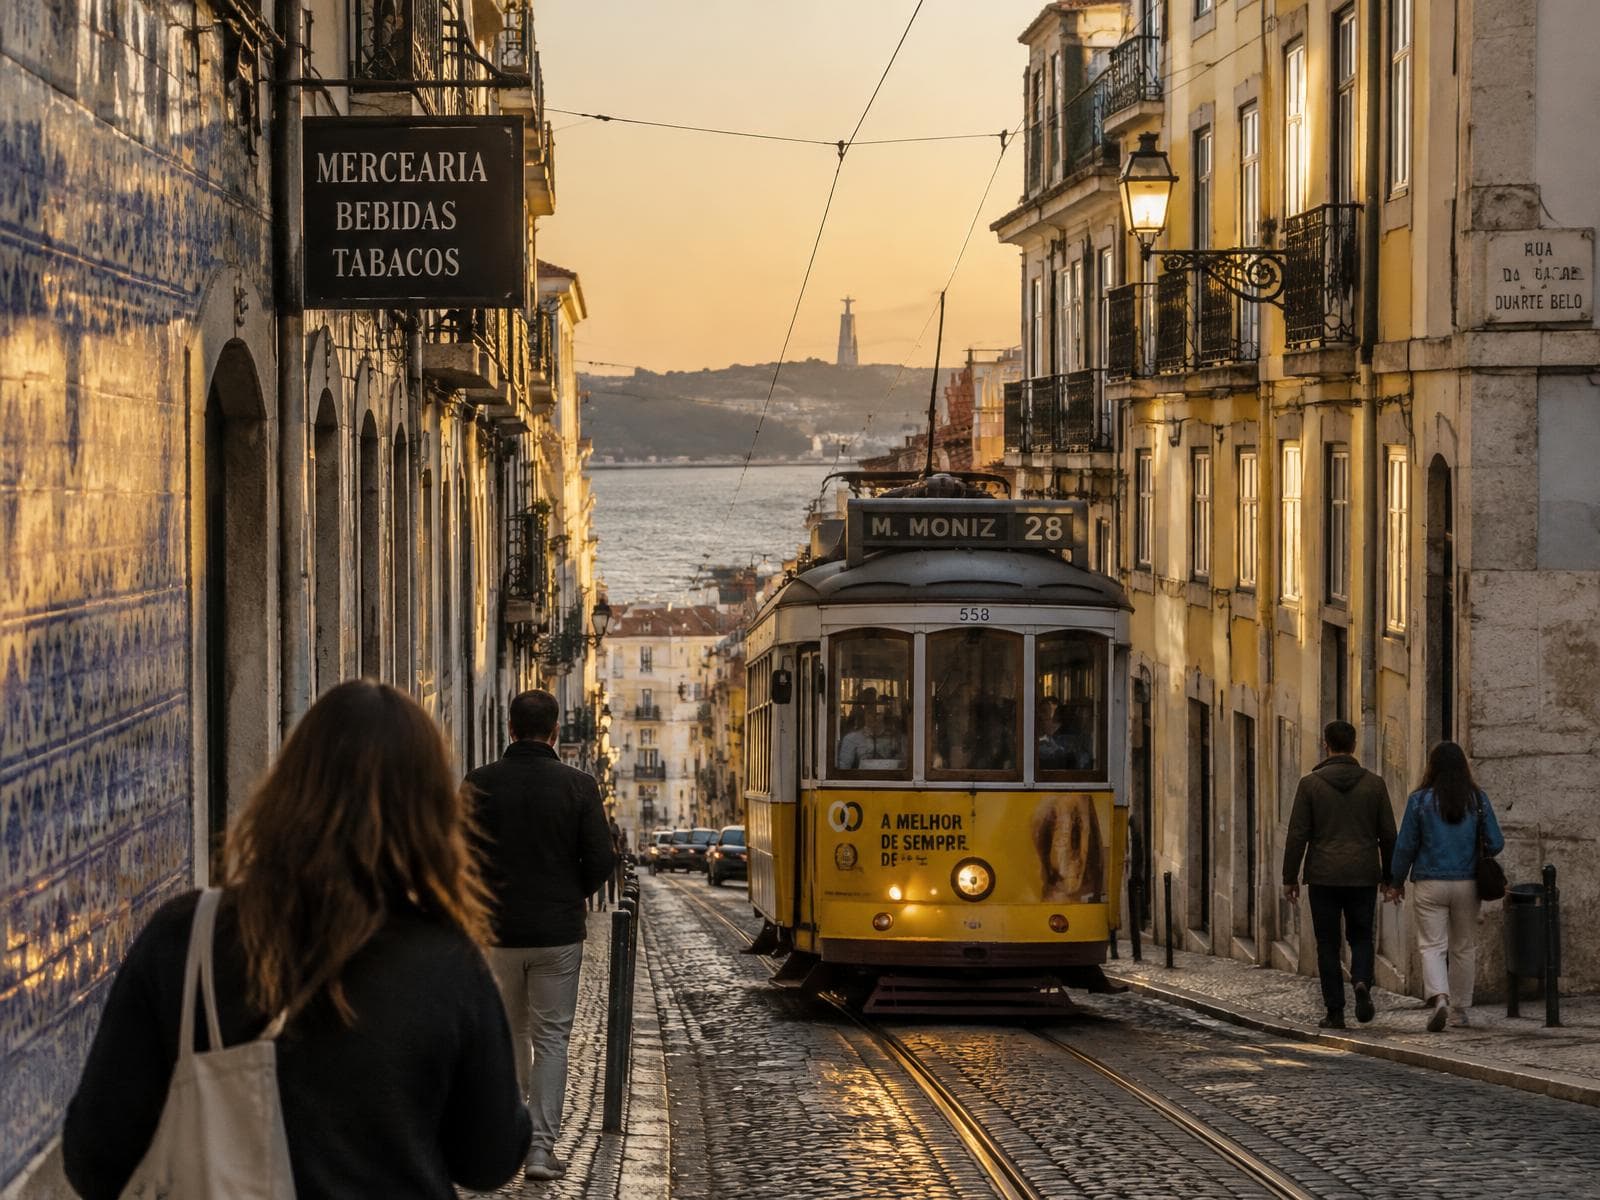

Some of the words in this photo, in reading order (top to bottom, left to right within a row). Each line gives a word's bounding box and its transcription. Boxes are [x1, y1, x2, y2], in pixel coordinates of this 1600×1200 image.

[316, 151, 488, 183] MERCEARIA
[336, 200, 457, 231] BEBIDAS
[1524, 242, 1553, 257] RUA
[332, 248, 460, 277] TABACOS
[1550, 294, 1582, 309] BELO
[871, 517, 899, 537] M.
[909, 517, 997, 538] MONIZ
[1024, 516, 1063, 541] 28
[959, 608, 990, 622] 558
[881, 813, 891, 829] A
[896, 813, 962, 830] MELHOR
[881, 834, 898, 850] DE
